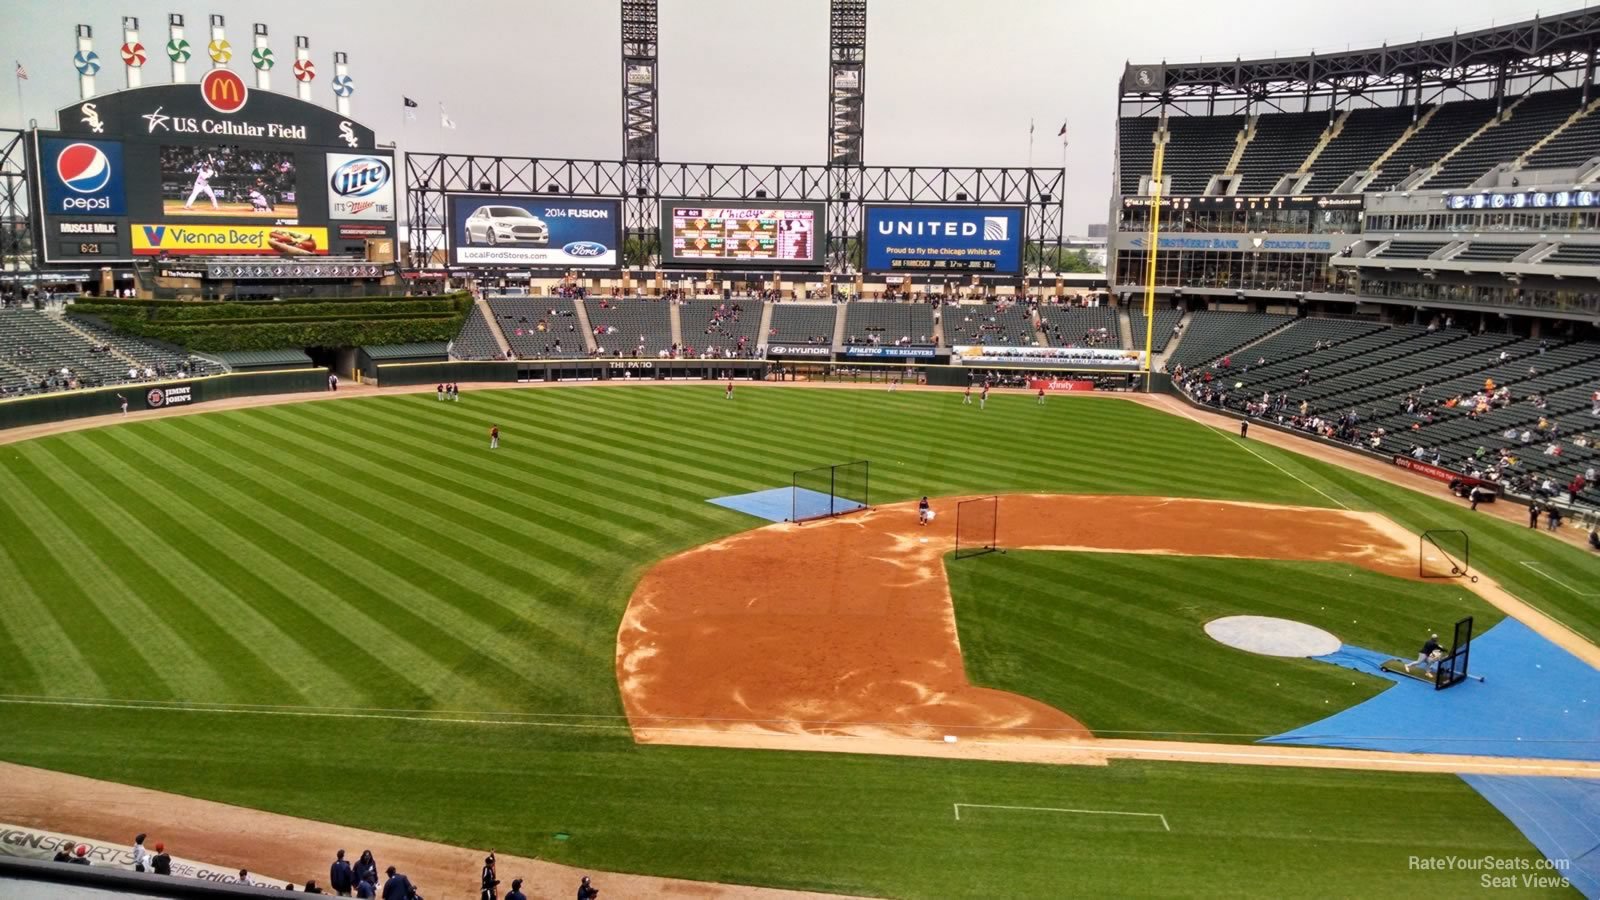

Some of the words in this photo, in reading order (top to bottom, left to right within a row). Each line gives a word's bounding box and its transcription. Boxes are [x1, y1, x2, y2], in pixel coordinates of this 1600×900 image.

[173, 116, 199, 133] U.S.
[201, 119, 265, 137] Cellular
[267, 123, 307, 139] Field
[63, 196, 110, 211] pepsi
[375, 204, 389, 213] TIME
[545, 208, 567, 218] 2014
[568, 209, 608, 219] FUSION
[60, 223, 93, 233] MUSCLE
[94, 223, 116, 234] MILK
[878, 220, 977, 236] UNITED
[170, 228, 226, 244] Vienna
[229, 230, 264, 248] Beef
[570, 243, 599, 256] Ford
[1264, 239, 1306, 249] STADIUM
[1308, 240, 1331, 249] CLUB
[464, 251, 548, 260] LocalFordStores.com
[916, 247, 926, 255] fly
[939, 247, 966, 256] Chicago
[788, 346, 829, 355] HYUNDAI
[165, 386, 191, 396] JIMMY
[1048, 381, 1074, 391] xfinity
[165, 394, 192, 405] JOHN'S
